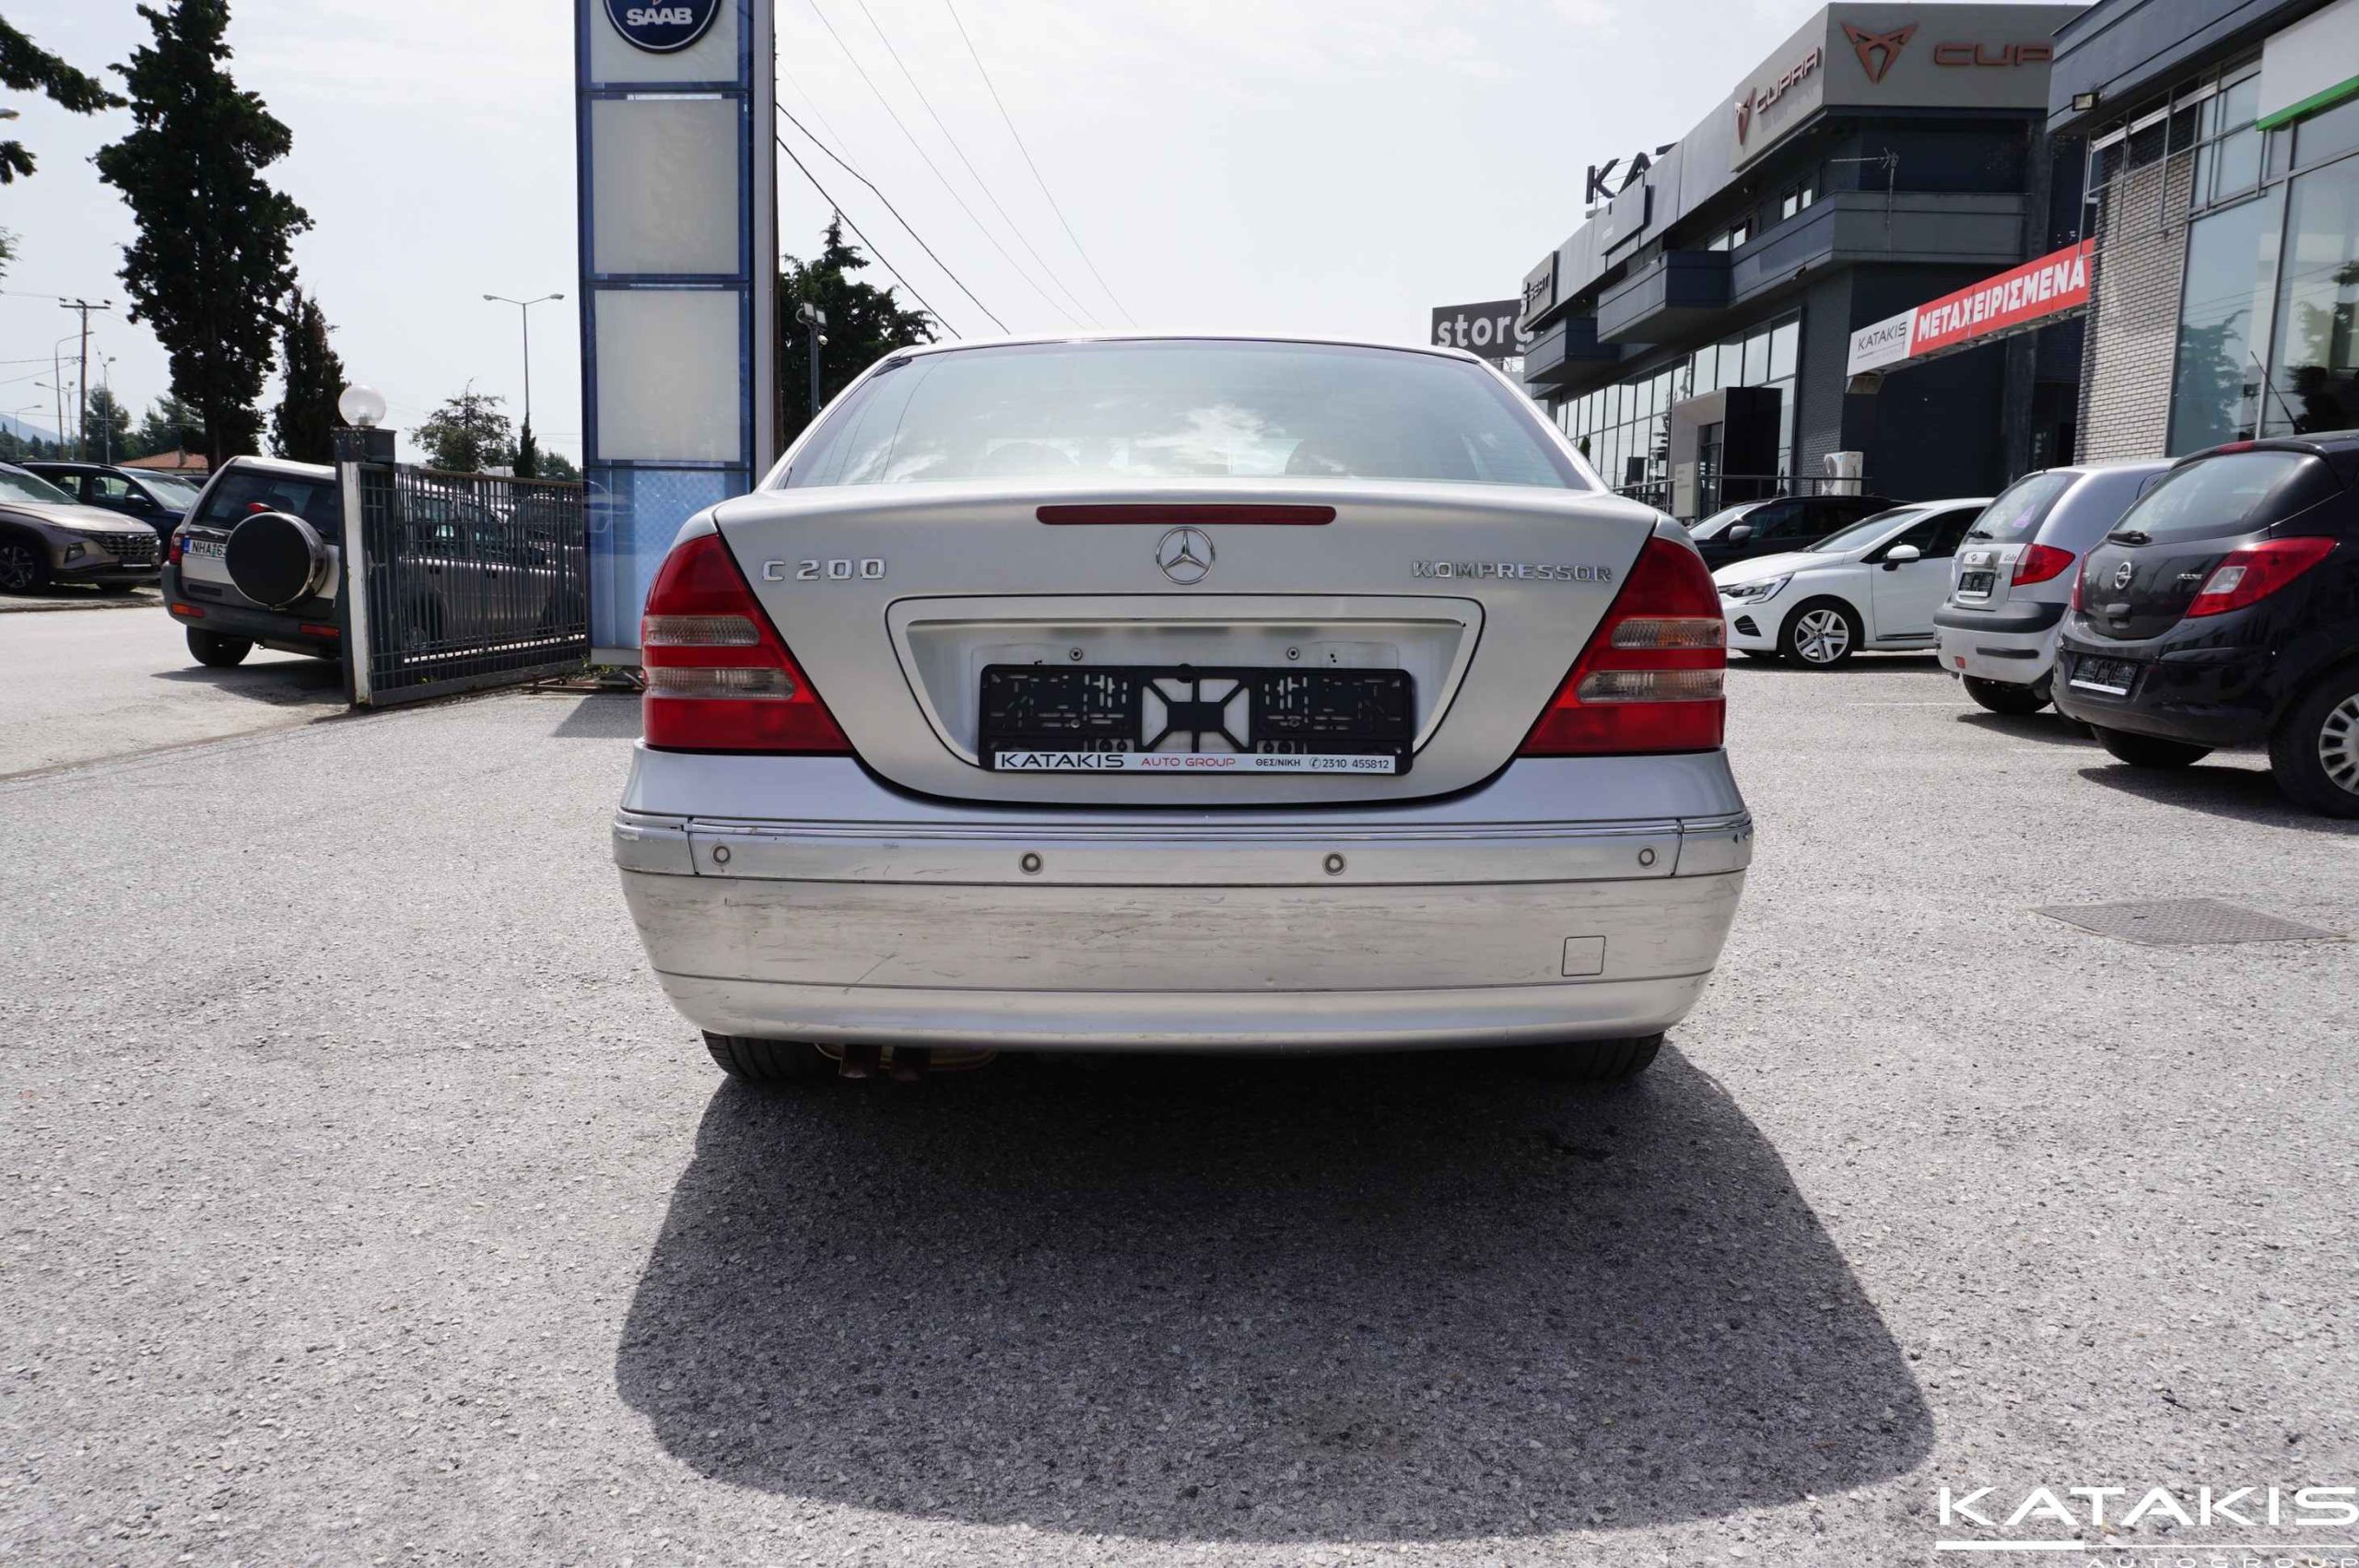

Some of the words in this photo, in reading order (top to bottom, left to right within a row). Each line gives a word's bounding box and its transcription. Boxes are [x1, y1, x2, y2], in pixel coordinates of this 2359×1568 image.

[626, 7, 693, 26] SAAB
[1755, 46, 1822, 113] CUPRA
[1585, 142, 1678, 205] KA
[1918, 255, 2085, 342] ΜΕΤΑΧΕΙΡΙΣΜΕΝΑ
[1858, 321, 1907, 352] KATAKIS
[762, 559, 785, 582] C
[796, 557, 886, 581] 200
[1412, 561, 1612, 582] KOMPRESSOR
[1001, 754, 1124, 768] KATAKIS
[1141, 757, 1180, 766] AUTO
[1185, 757, 1236, 767] GROUP
[1322, 759, 1347, 768] 2310
[1352, 760, 1390, 769] 455812
